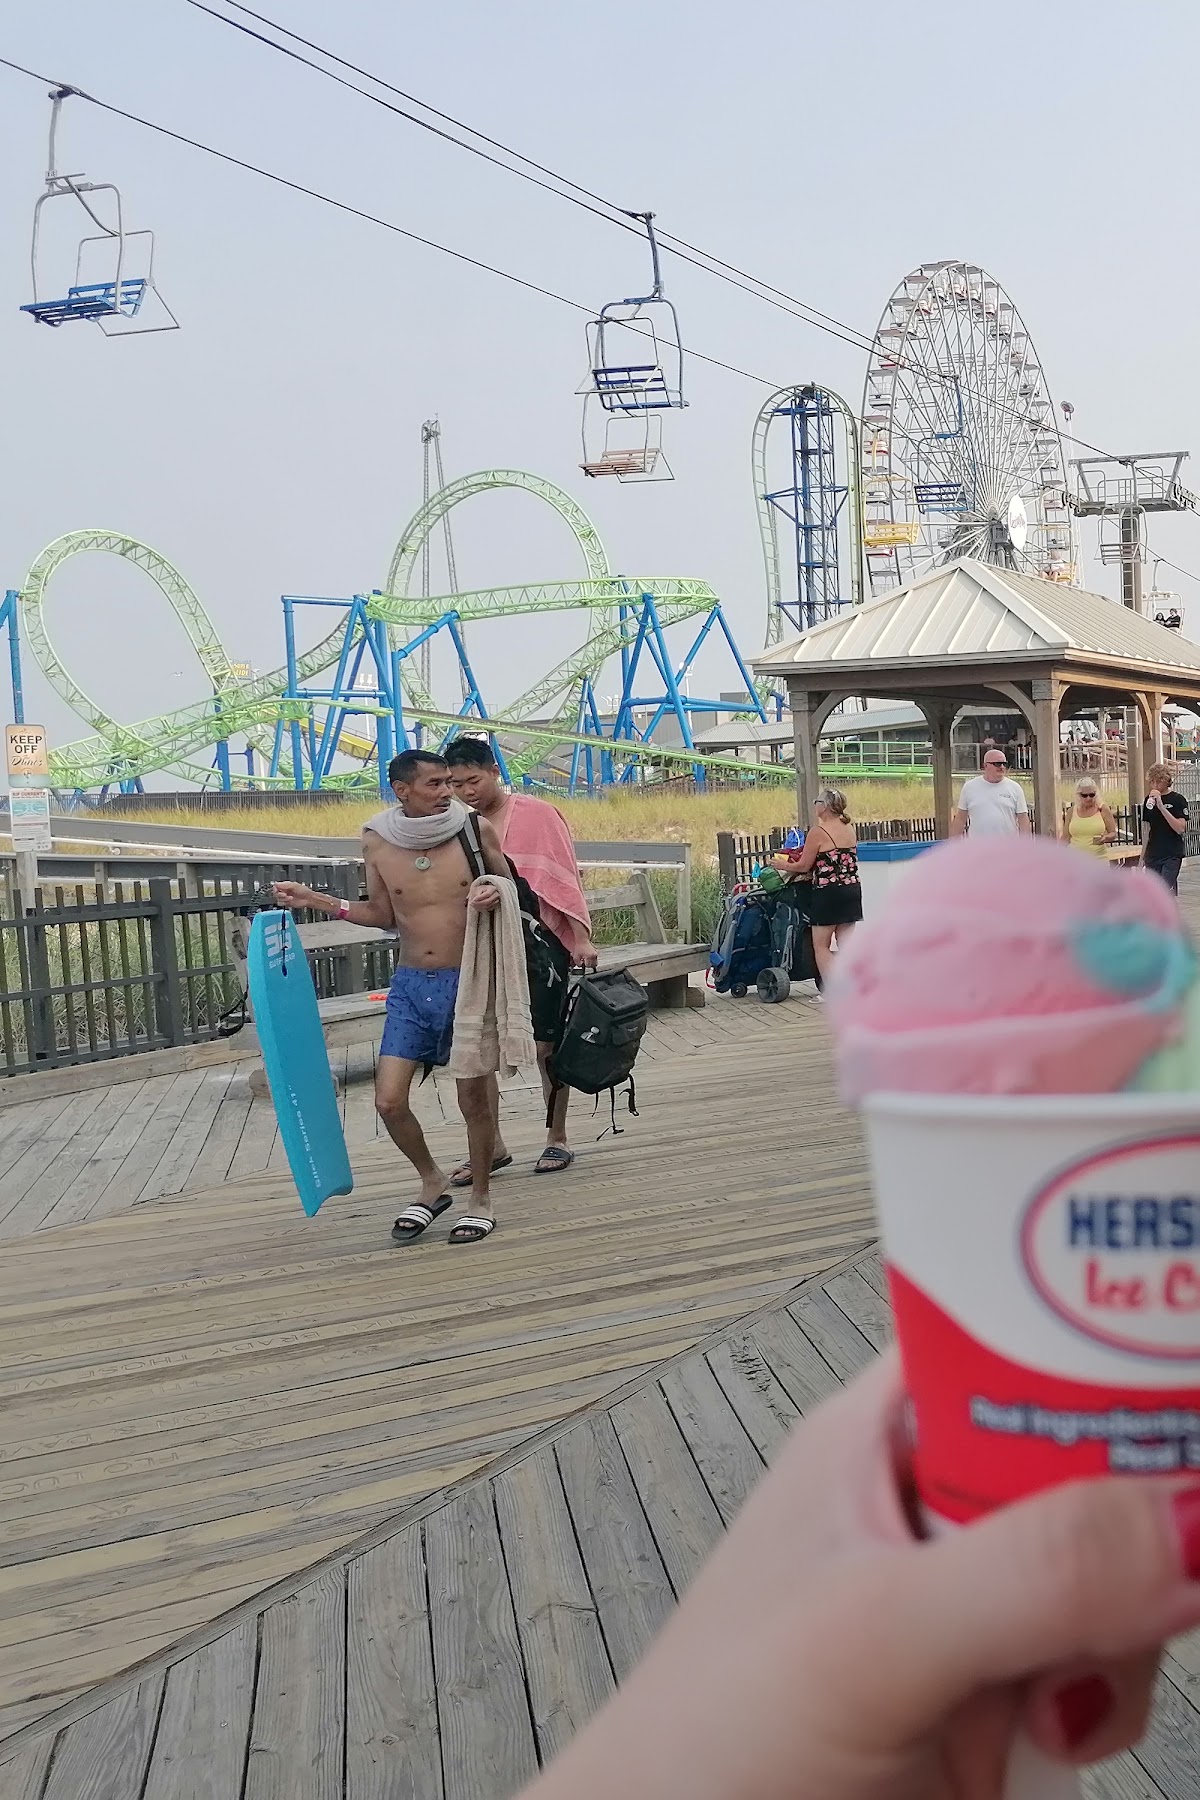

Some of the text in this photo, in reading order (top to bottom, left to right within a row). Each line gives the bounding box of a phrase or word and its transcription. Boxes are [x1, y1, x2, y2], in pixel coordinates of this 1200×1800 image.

[10, 735, 43, 744] KEEP
[14, 744, 38, 754] OFF
[1085, 1257, 1144, 1312] Ice
[211, 1330, 319, 1355] BRADY
[77, 1350, 194, 1380] THOSE
[155, 1395, 291, 1426] ALISON
[103, 1450, 178, 1476] FLO
